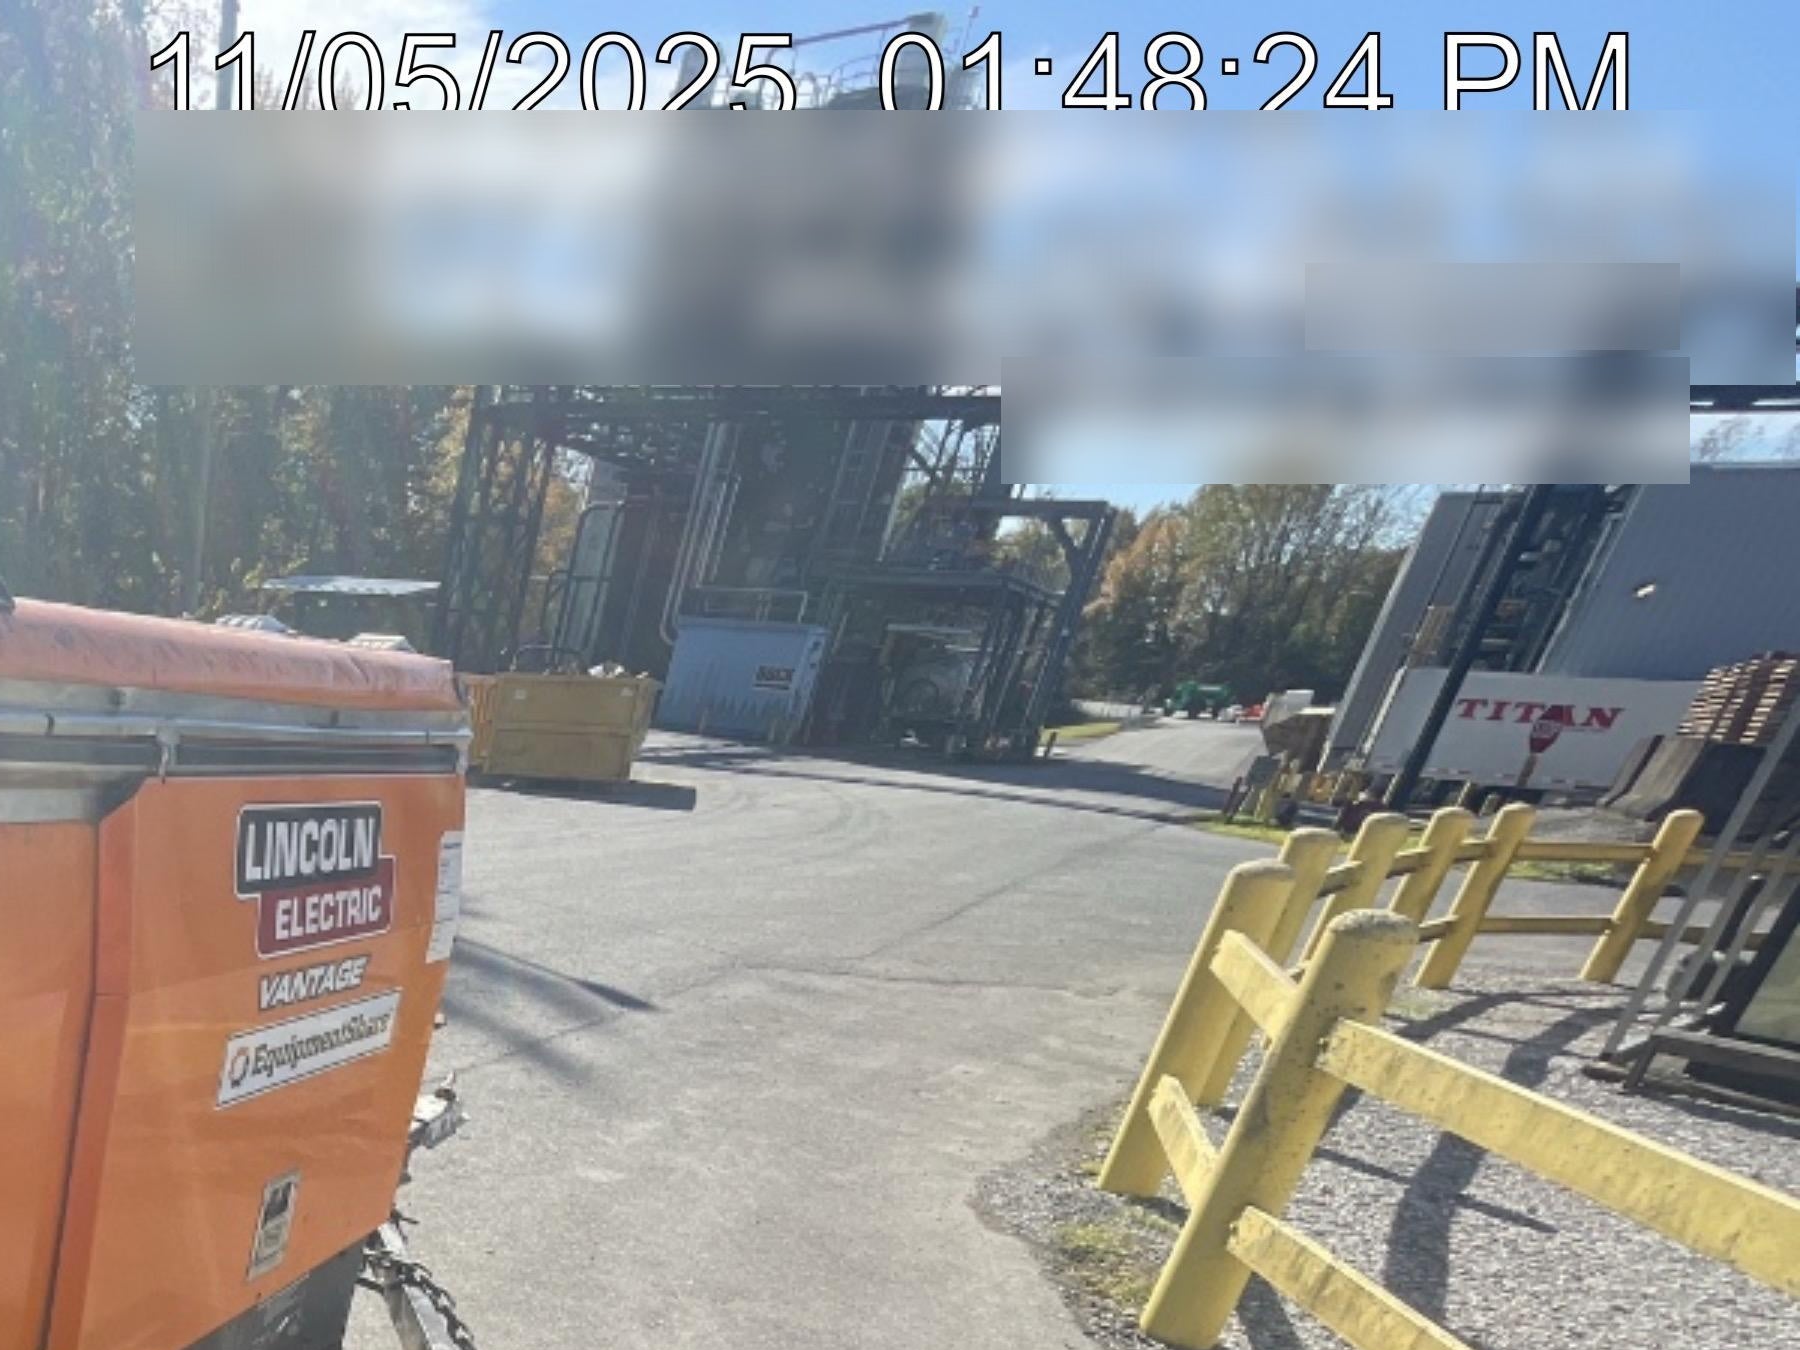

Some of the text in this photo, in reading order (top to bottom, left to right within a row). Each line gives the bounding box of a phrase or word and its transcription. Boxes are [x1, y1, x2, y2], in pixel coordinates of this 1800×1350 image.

[1456, 698, 1626, 729] TITAN
[245, 817, 375, 882] LINCOLN
[275, 885, 382, 940] ELECTRIC
[260, 955, 370, 1009] VANTAGE
